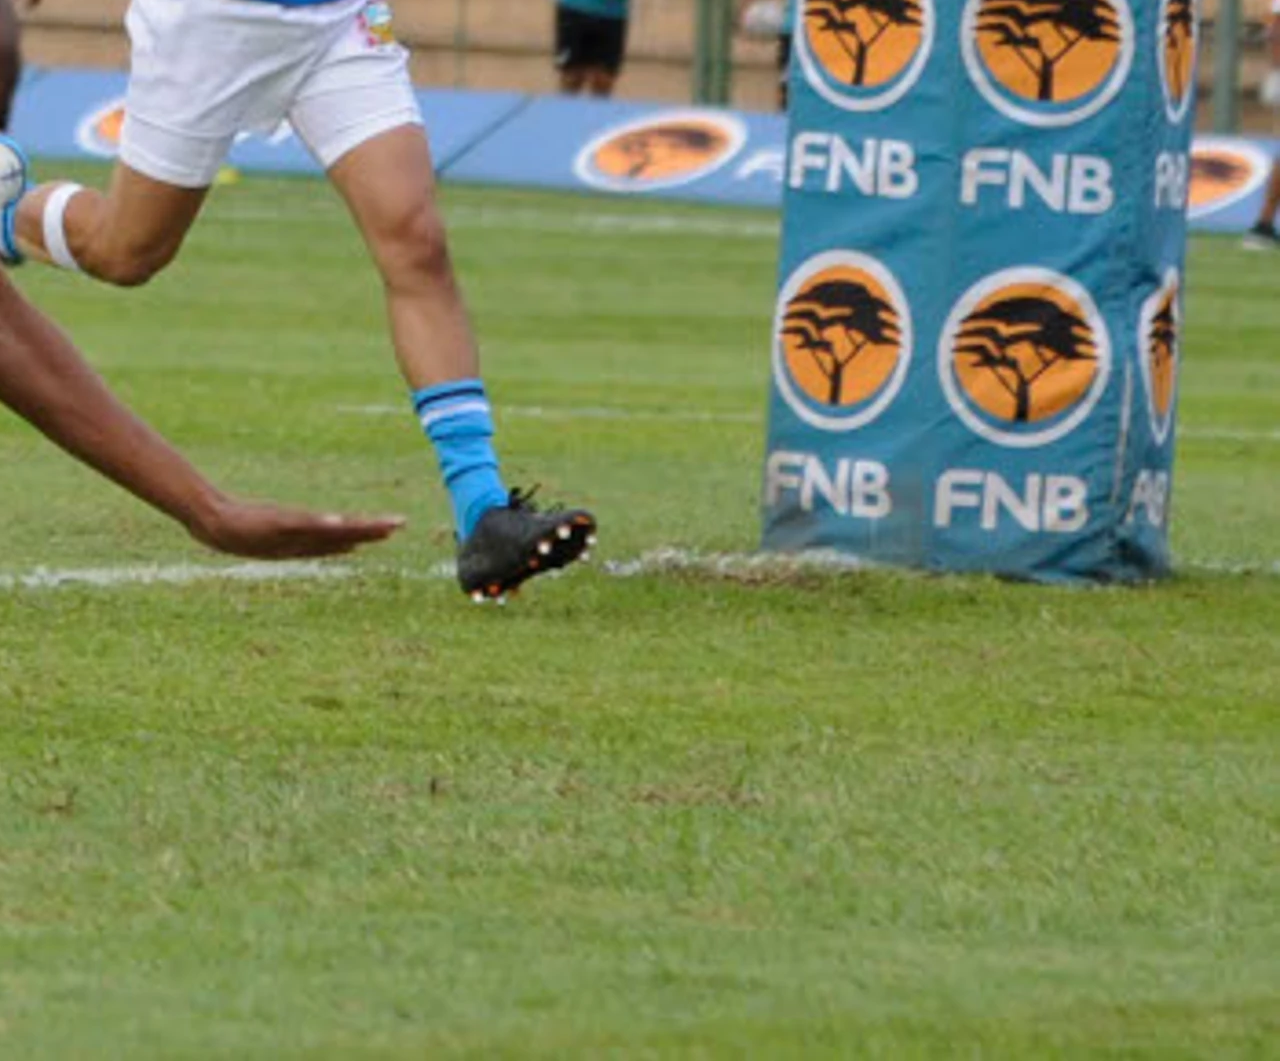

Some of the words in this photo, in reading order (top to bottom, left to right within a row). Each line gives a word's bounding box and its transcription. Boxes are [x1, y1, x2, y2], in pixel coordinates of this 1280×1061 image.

[788, 130, 919, 199] FNB
[959, 147, 1116, 215] FNB
[764, 450, 893, 519] FNB
[932, 468, 1091, 533] FNB
